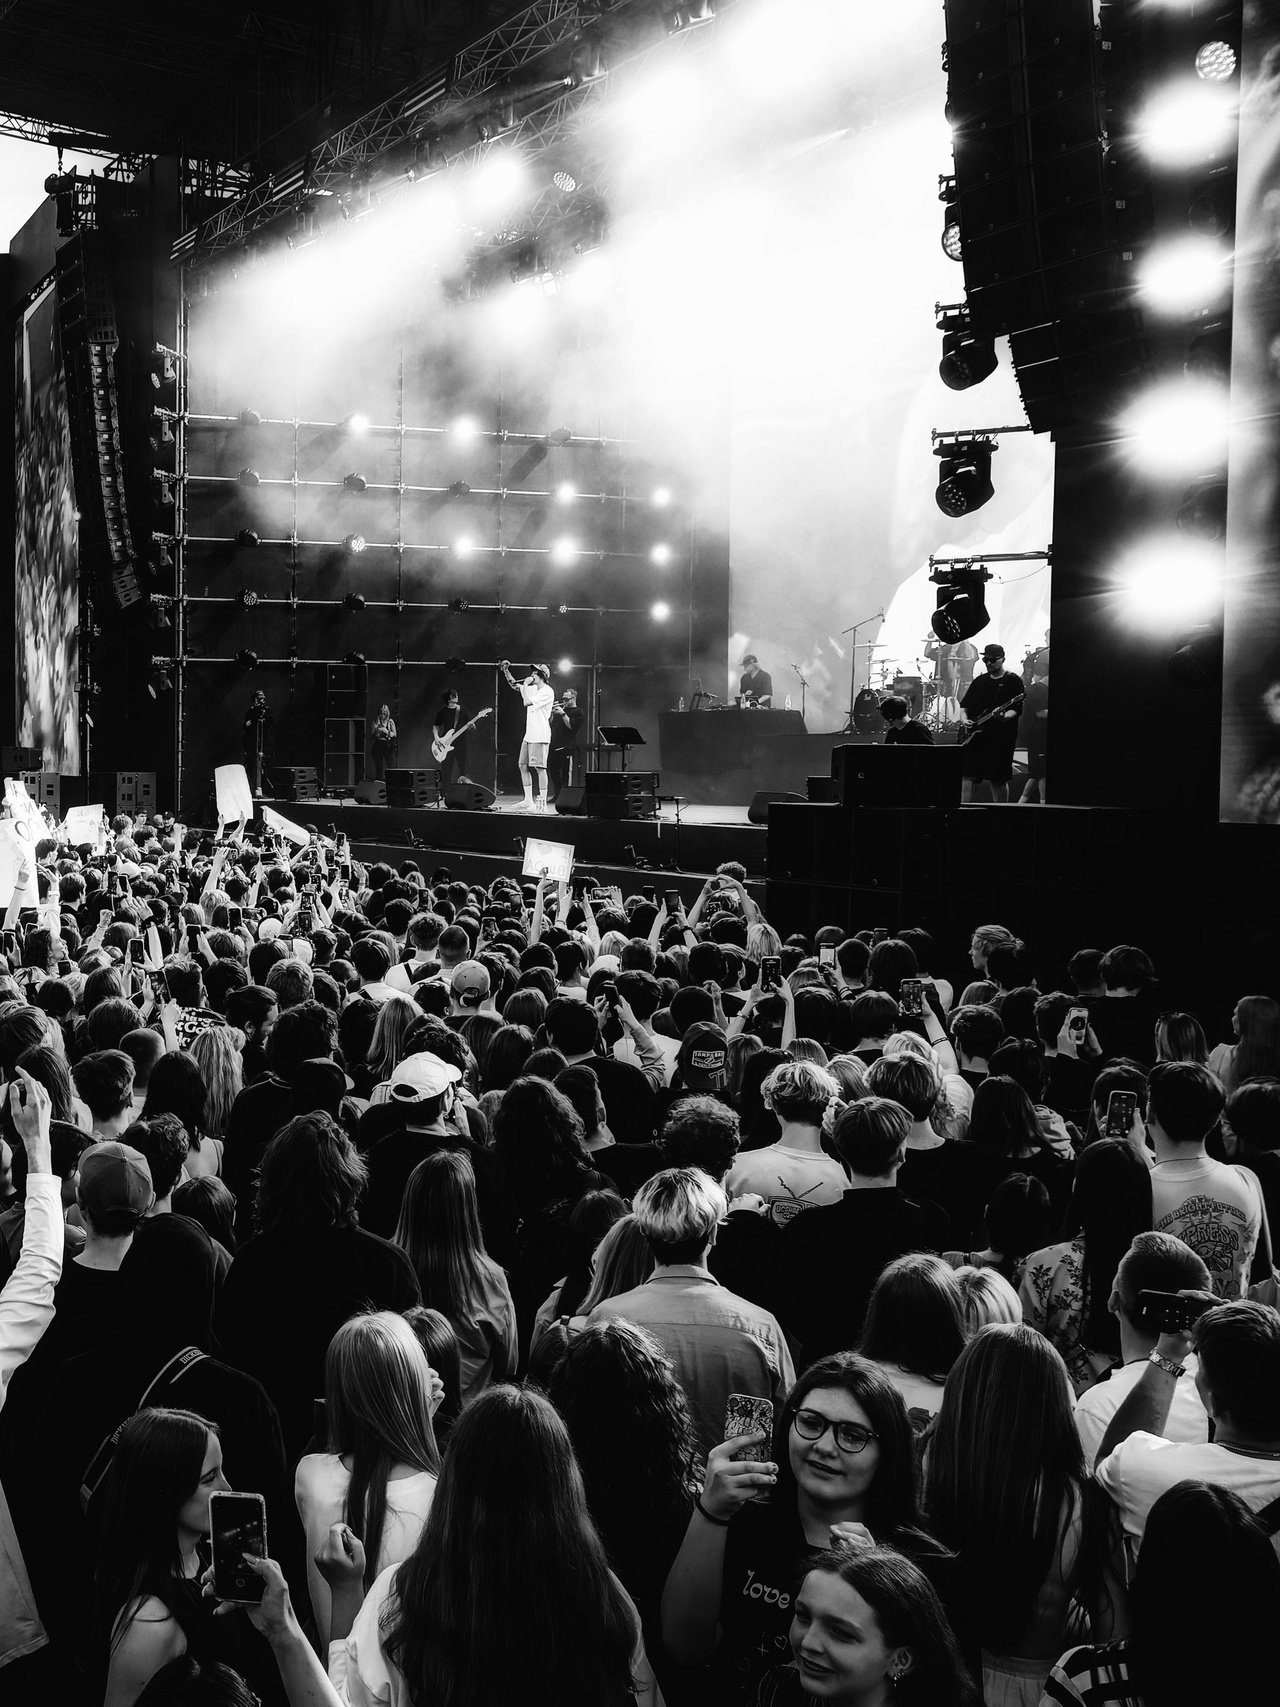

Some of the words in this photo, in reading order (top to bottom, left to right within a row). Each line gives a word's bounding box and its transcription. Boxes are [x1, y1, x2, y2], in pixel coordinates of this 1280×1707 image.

[708, 1068, 727, 1088] 77
[1156, 1213, 1174, 1231] THE
[1173, 1203, 1209, 1218] BRIGHT
[1211, 1200, 1246, 1222] FUTURE
[742, 1569, 790, 1609] love
